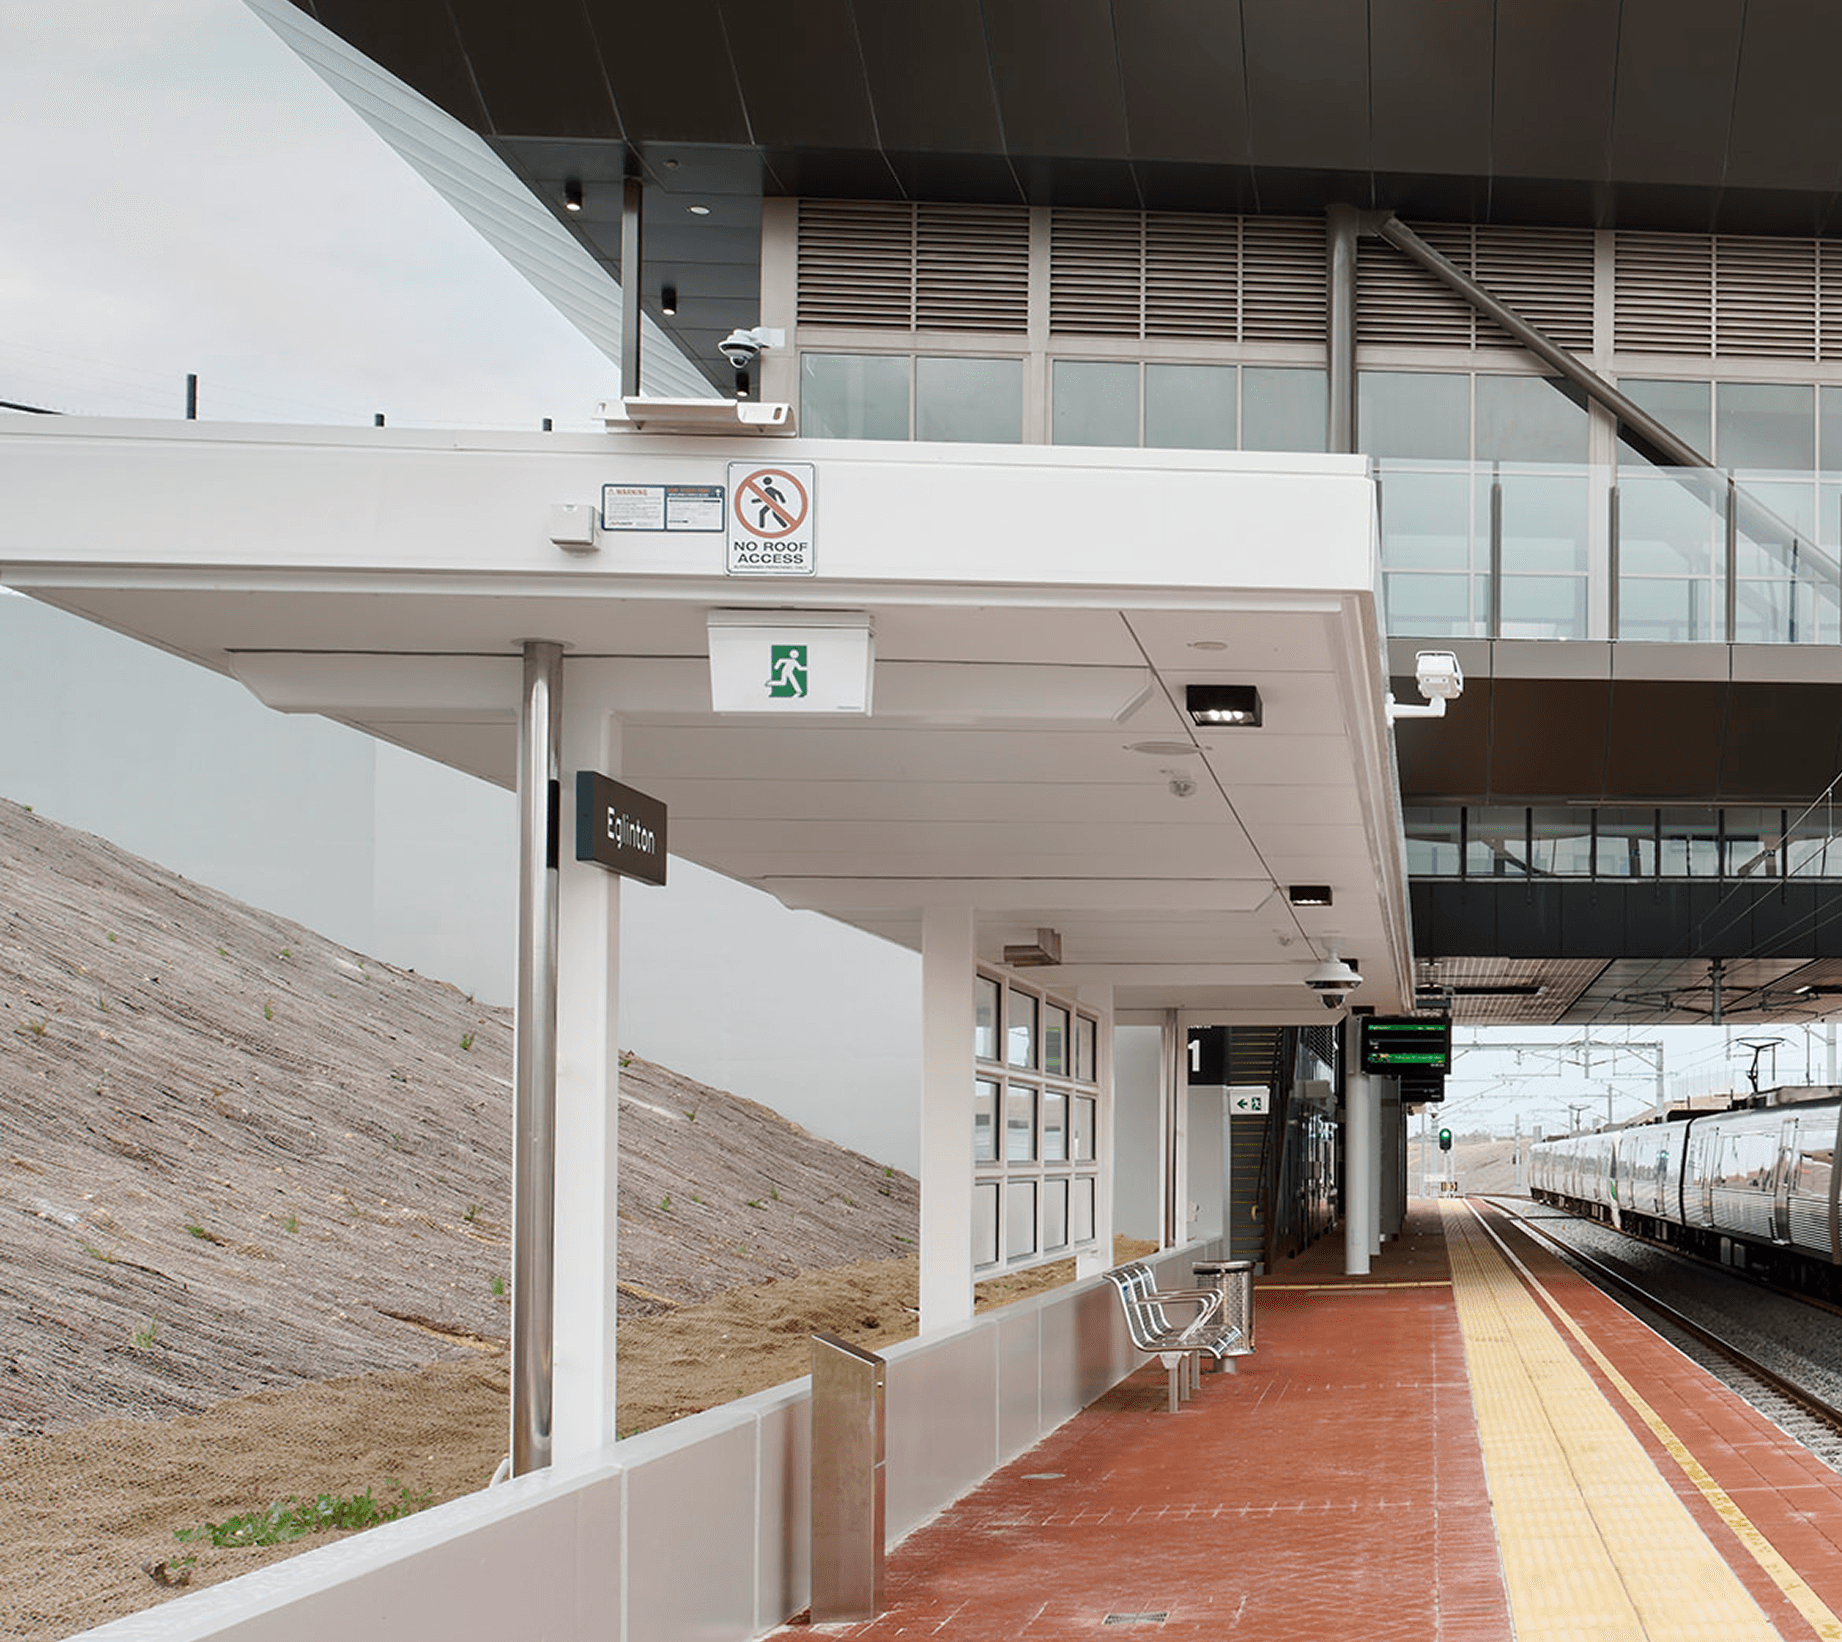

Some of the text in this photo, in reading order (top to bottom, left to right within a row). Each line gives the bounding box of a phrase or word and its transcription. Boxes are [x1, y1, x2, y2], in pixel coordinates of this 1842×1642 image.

[734, 541, 808, 552] NO ROOF
[737, 553, 804, 564] ACCESS
[607, 805, 656, 855] Eglinton
[1187, 1039, 1201, 1073] 1
